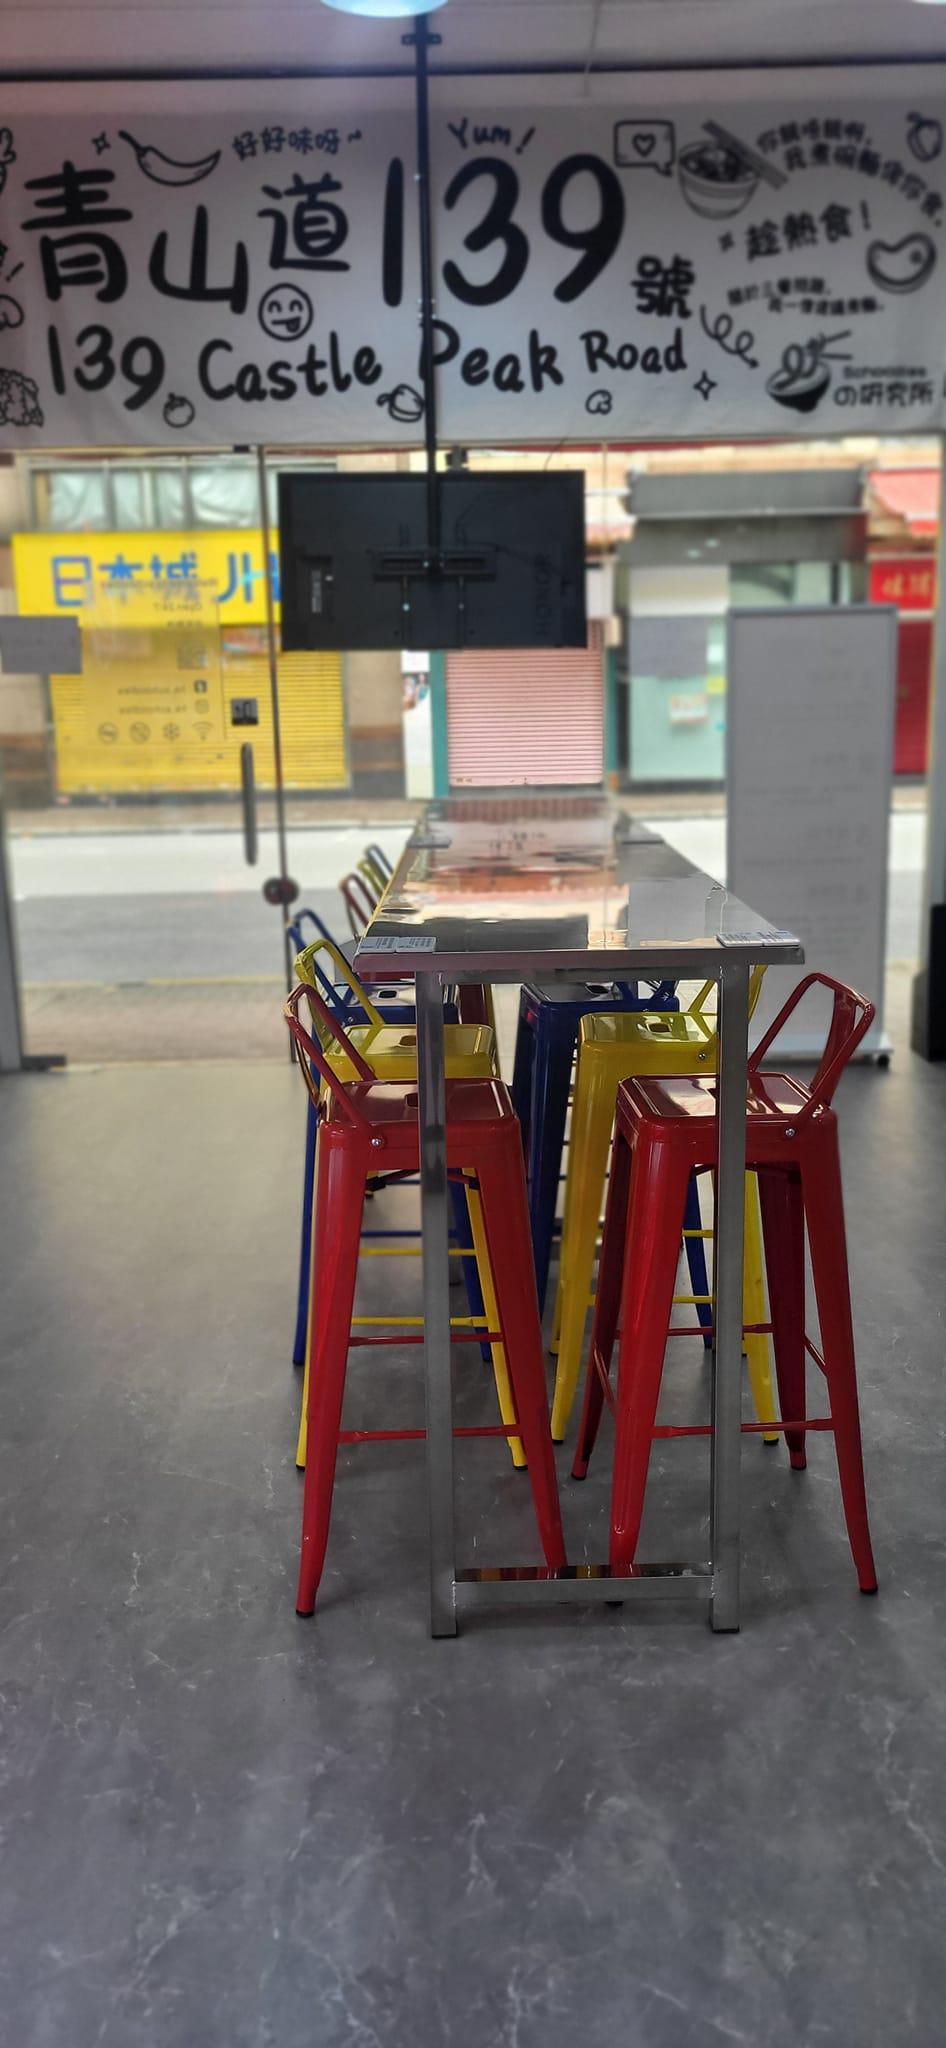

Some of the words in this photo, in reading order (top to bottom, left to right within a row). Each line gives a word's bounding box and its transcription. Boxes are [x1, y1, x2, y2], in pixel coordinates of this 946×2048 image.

[447, 116, 536, 154] Yum!
[48, 324, 165, 411] 139
[198, 330, 382, 402] Castle
[419, 318, 564, 393] Peak
[580, 326, 687, 374] Road
